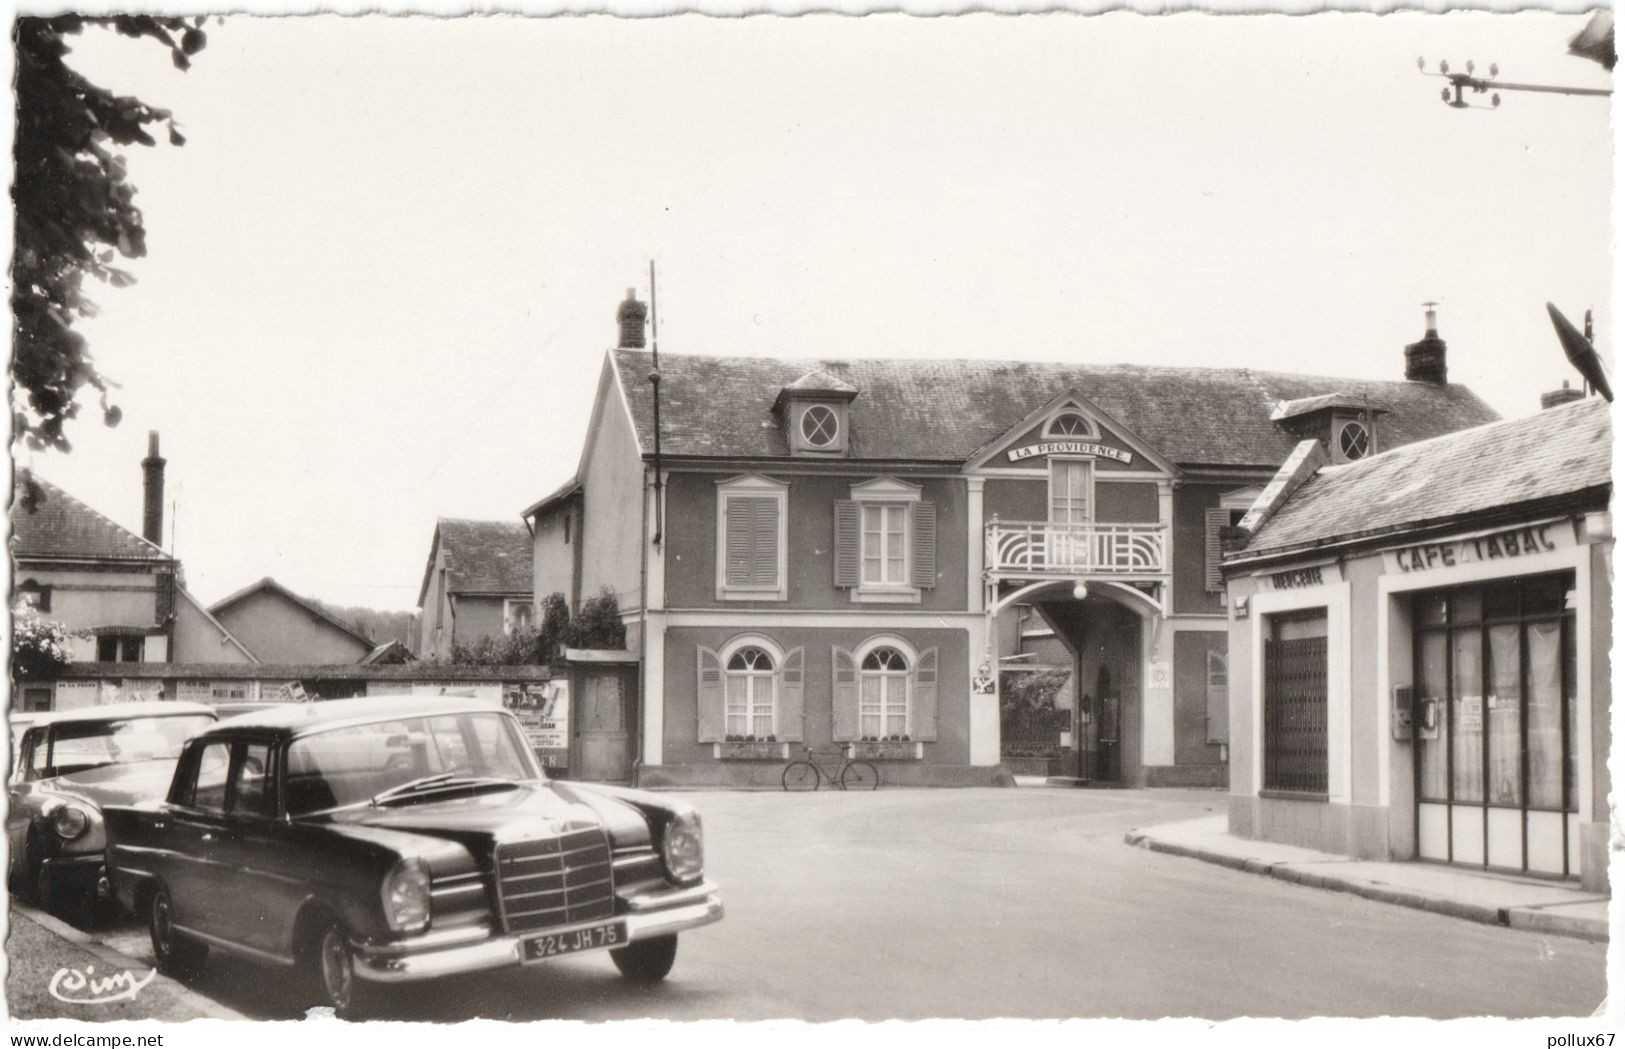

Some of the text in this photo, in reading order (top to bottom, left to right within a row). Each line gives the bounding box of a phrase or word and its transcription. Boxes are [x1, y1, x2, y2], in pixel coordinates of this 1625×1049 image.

[1016, 442, 1126, 460] LA PROVIDENCE
[1472, 525, 1555, 562] TABAC
[534, 925, 617, 957] 324 JH 75
